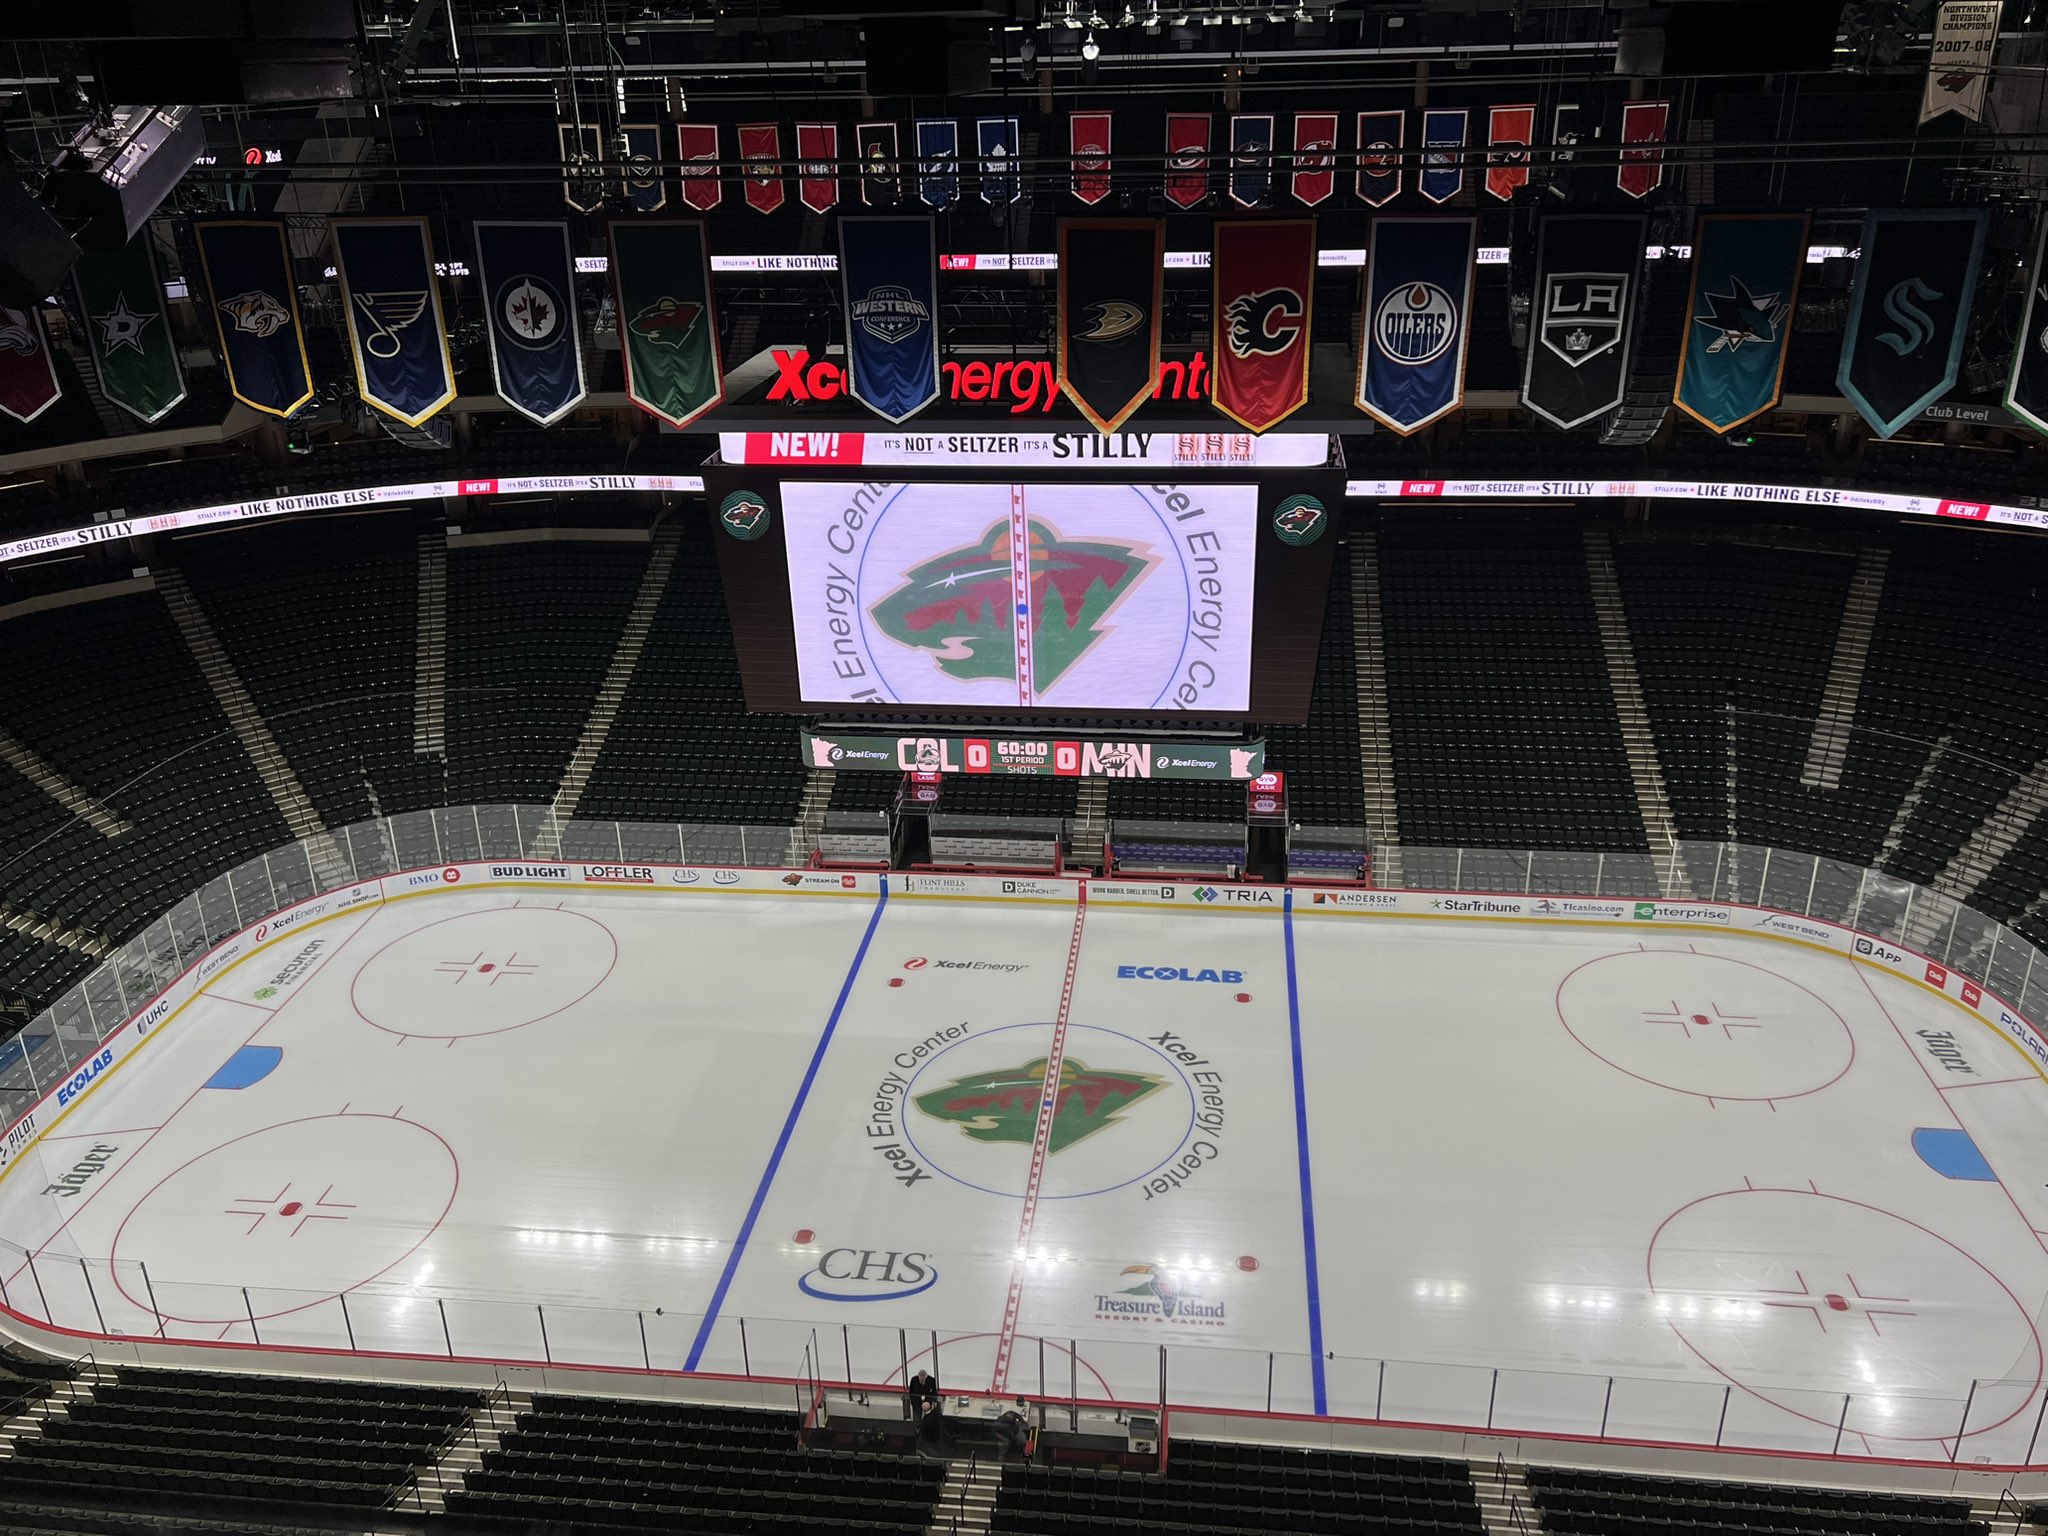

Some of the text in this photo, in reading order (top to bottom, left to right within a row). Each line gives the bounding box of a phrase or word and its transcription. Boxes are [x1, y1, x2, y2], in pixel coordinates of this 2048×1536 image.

[1942, 22, 1992, 30] CHAMPIONS
[1935, 41, 1992, 52] 2007-08
[757, 257, 783, 268] LIKE
[786, 257, 839, 269] NOTHING
[992, 258, 1005, 267] NOT
[1011, 257, 1045, 266] SELTZER
[1551, 284, 1620, 313] LA
[854, 300, 926, 316] WESTERN
[1385, 312, 1446, 336] OILERS
[1926, 406, 1989, 421] Club Level
[770, 432, 1151, 459] NEW! IT'S NOT A SELTZER IT'S A STILLY
[466, 482, 490, 493] NEW!
[518, 480, 533, 488] NOT
[540, 479, 574, 488] SELTZER
[589, 477, 636, 488] STILLY
[1409, 484, 1436, 493] NEW!
[1486, 484, 1524, 492] SELTZER
[1541, 482, 1595, 495] STILLY
[1697, 484, 1728, 496] LIKE
[1734, 486, 1800, 501] NOTHING
[1805, 490, 1841, 503] ELSE
[1947, 504, 1980, 516] NEW!
[2014, 512, 2033, 521] NOT
[16, 537, 59, 553] SELTZER
[77, 522, 133, 543] STILLY
[198, 510, 231, 520] STILLY.COM
[240, 502, 271, 516] LIKE
[276, 494, 339, 511] NOTHING
[344, 490, 375, 503] ELSE
[1186, 531, 1223, 652] Energy
[826, 562, 866, 679] Energy
[897, 738, 986, 772] COL 0
[997, 742, 1048, 756] 60:00
[1015, 756, 1045, 764] PERIOD
[1056, 742, 1151, 778] 0 MIN
[1007, 766, 1038, 774] SHOTS
[409, 873, 439, 886] BMO
[493, 867, 567, 878] BUD LIGHT
[583, 866, 653, 879] LOFFLER
[674, 869, 697, 879] CHS
[715, 870, 738, 880] CHS
[920, 879, 942, 887] FLINT
[1017, 887, 1049, 895] CANNON
[1224, 889, 1273, 902] TRIA
[1339, 894, 1397, 903] ANDERSEN
[1444, 899, 1520, 913] StarTribune
[1641, 907, 1728, 920] enterprise
[1772, 922, 1801, 932] WEST
[1801, 927, 1830, 939] BEND
[202, 958, 220, 975] WEST
[219, 946, 239, 961] BEND
[271, 939, 325, 985] securian
[285, 953, 322, 985] FINANCIAL
[1117, 965, 1244, 984] ECOLAB
[147, 1001, 169, 1025] UHC
[56, 1049, 113, 1107] ECOLAB
[866, 1021, 969, 1188] Xcel Energy Center
[1143, 1031, 1225, 1201] Xcel Energy Center
[8, 1114, 36, 1145] PILOT
[818, 1248, 927, 1283] CHS
[1094, 1295, 1226, 1318] Treasure Island
[1095, 1314, 1148, 1322] RESORT
[1171, 1318, 1226, 1326] CASINO
